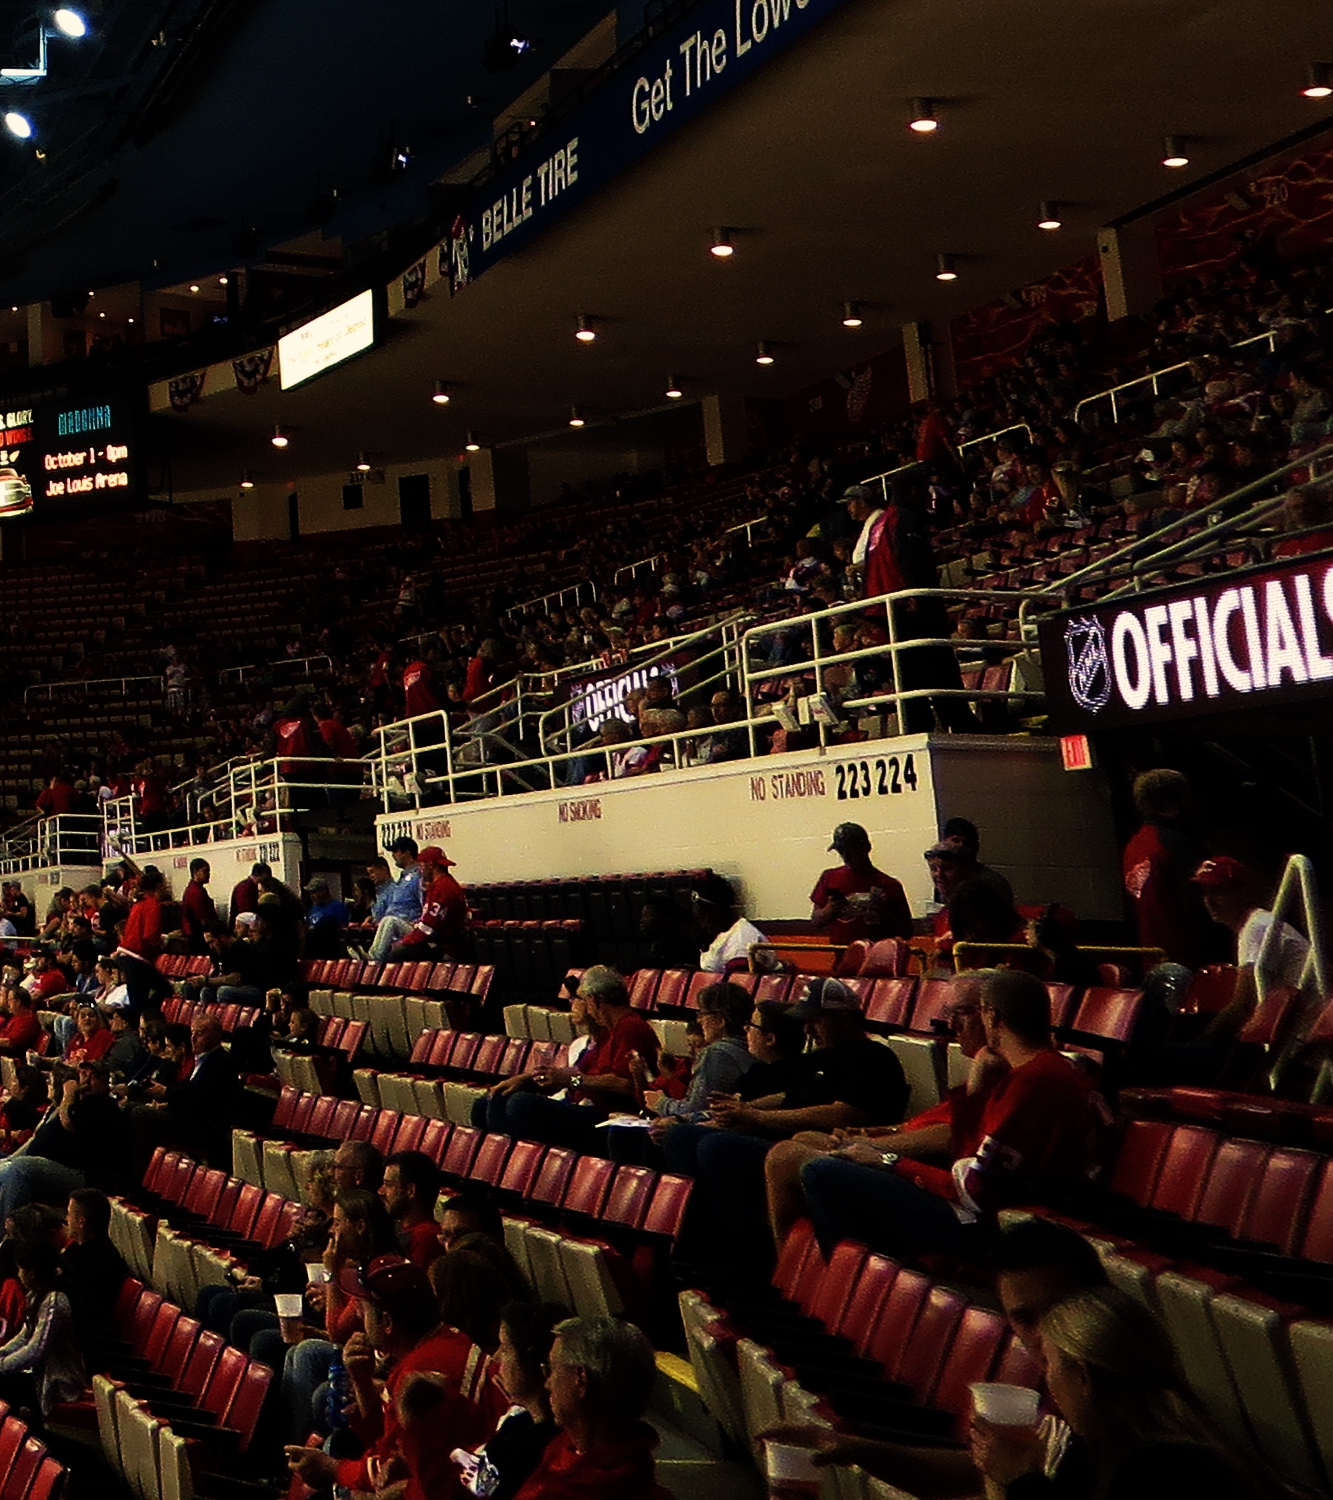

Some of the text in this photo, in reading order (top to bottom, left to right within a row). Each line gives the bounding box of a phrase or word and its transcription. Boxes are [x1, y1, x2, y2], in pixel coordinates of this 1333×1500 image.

[633, 60, 673, 134] Get
[680, 29, 727, 96] The
[483, 137, 578, 252] BELLE TIRE
[45, 452, 87, 470] October
[46, 472, 128, 496] Joe Louis Arena
[751, 770, 827, 800] NO STANDING
[837, 754, 917, 800] 223 224
